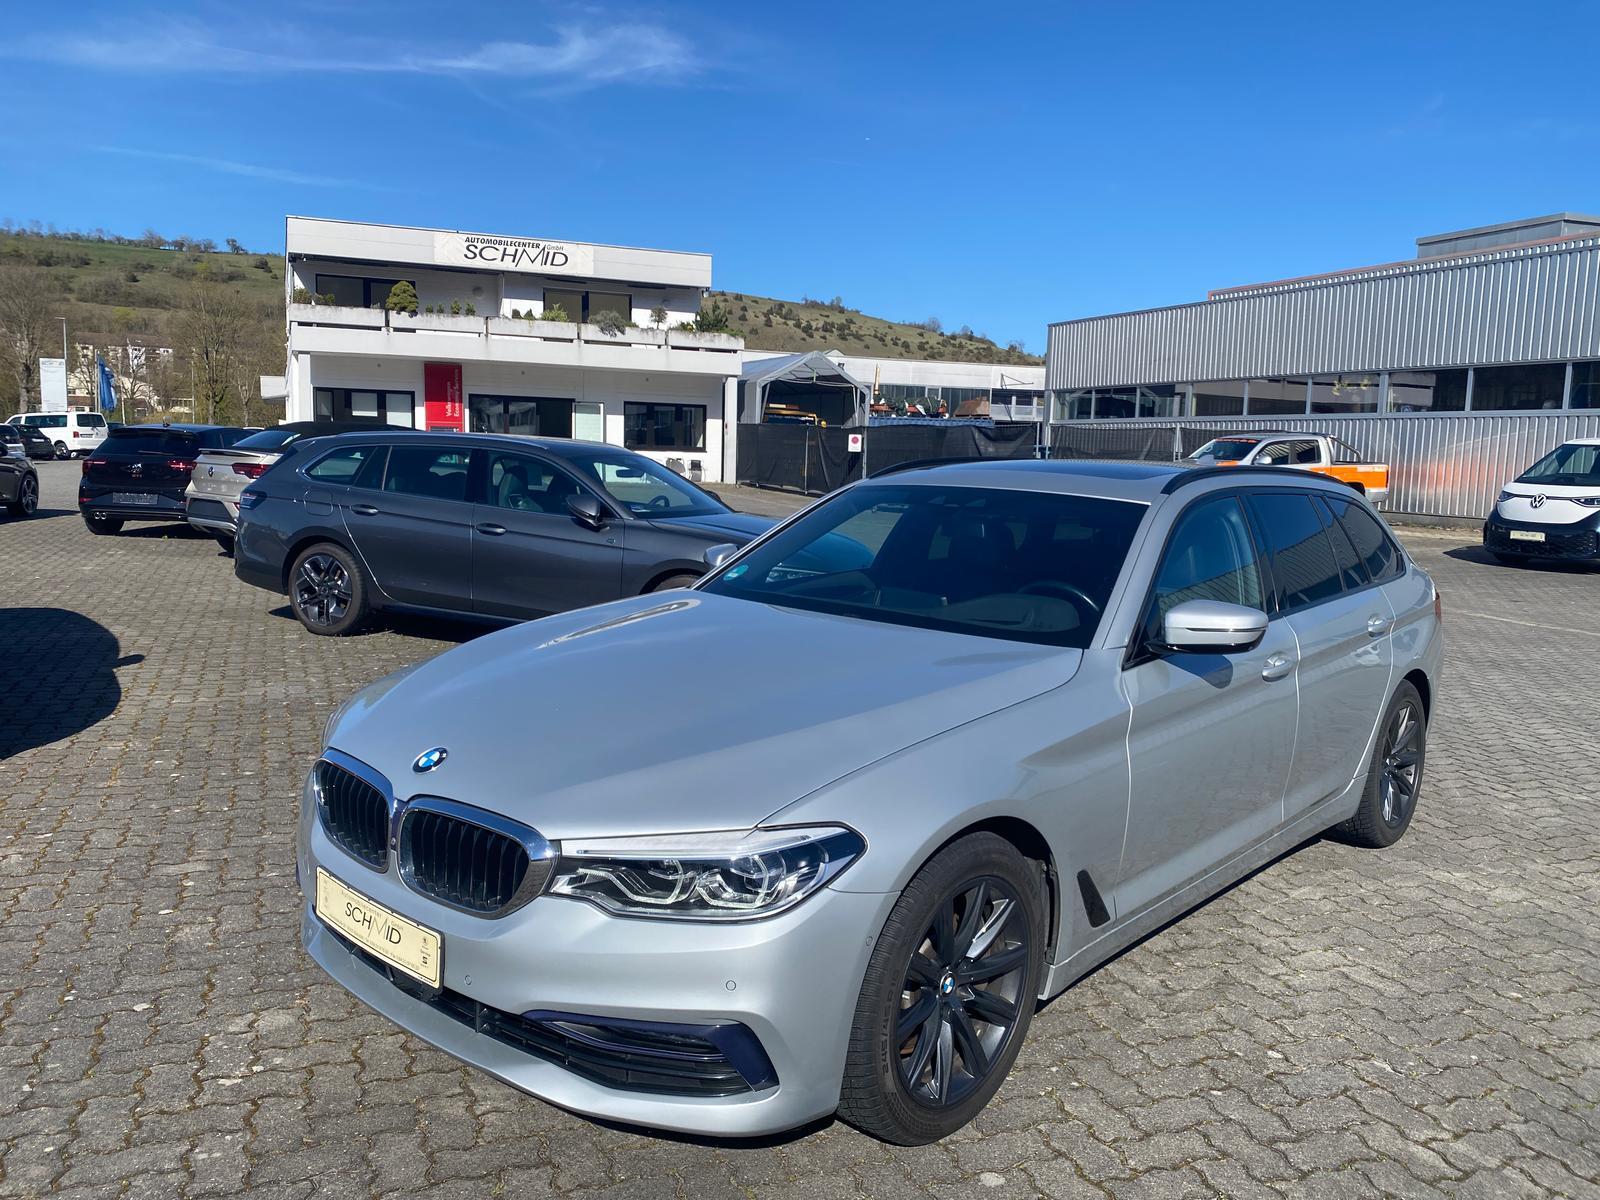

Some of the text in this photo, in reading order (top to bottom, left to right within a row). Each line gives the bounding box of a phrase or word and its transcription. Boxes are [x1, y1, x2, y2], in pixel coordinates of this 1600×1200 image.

[465, 236, 541, 249] AUTOMOBILECENTER
[546, 244, 564, 252] GmbH
[463, 243, 569, 268] SCHMID
[344, 901, 402, 945] SCHMID
